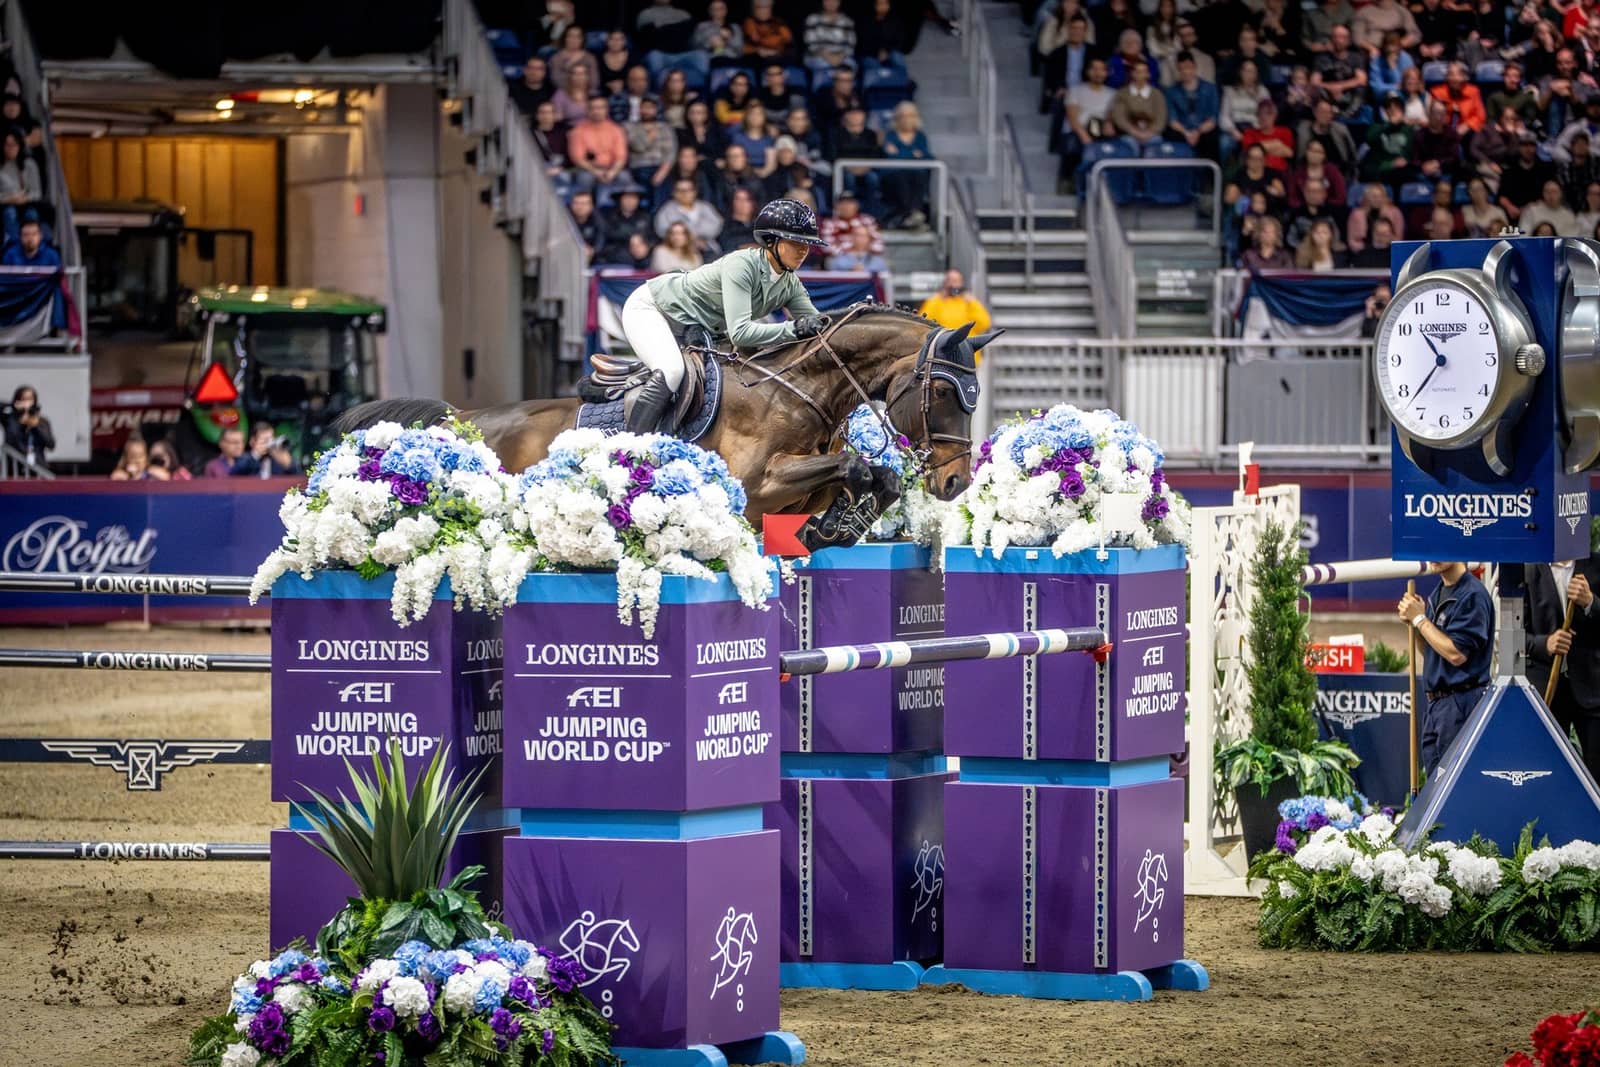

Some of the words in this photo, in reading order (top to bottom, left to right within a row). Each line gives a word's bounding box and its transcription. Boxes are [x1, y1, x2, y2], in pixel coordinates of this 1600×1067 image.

[1414, 302, 1424, 315] 11
[1435, 293, 1451, 306] 12
[1465, 301, 1470, 314] 1
[1398, 323, 1412, 336] 10
[1419, 323, 1467, 333] LONGINES
[1478, 322, 1489, 335] 2
[1391, 354, 1402, 367] 9
[1485, 353, 1497, 367] 3
[1398, 384, 1409, 398] 8
[1477, 384, 1489, 397] 4
[1415, 407, 1426, 420] 7
[1439, 415, 1450, 428] 6
[1463, 407, 1473, 420] 5
[1404, 494, 1532, 518] LONGINES
[1558, 492, 1588, 517] LONGINES
[3, 515, 157, 573] Royal
[80, 575, 208, 595] LONGINES
[1126, 606, 1178, 631] LONGINES
[82, 652, 209, 671] LONGINES
[298, 640, 430, 662] LONGINES
[526, 644, 660, 666] LONGINES
[696, 638, 767, 665] LONGINES
[1142, 645, 1164, 667] FEI
[338, 682, 392, 703] FEI
[718, 681, 747, 705] FEI
[1131, 671, 1173, 696] JUMPING
[567, 687, 621, 707] FEI
[898, 689, 933, 711] WORLD
[1125, 695, 1159, 718] WORLD
[1312, 690, 1411, 714] NGINES
[311, 711, 418, 733] JUMPING
[539, 717, 648, 738] JUMPING
[704, 710, 761, 737] JUMPING
[296, 735, 381, 756] WORLD
[523, 740, 610, 761] WORLD
[696, 736, 741, 762] WORLD
[79, 842, 208, 860] LONGINES
